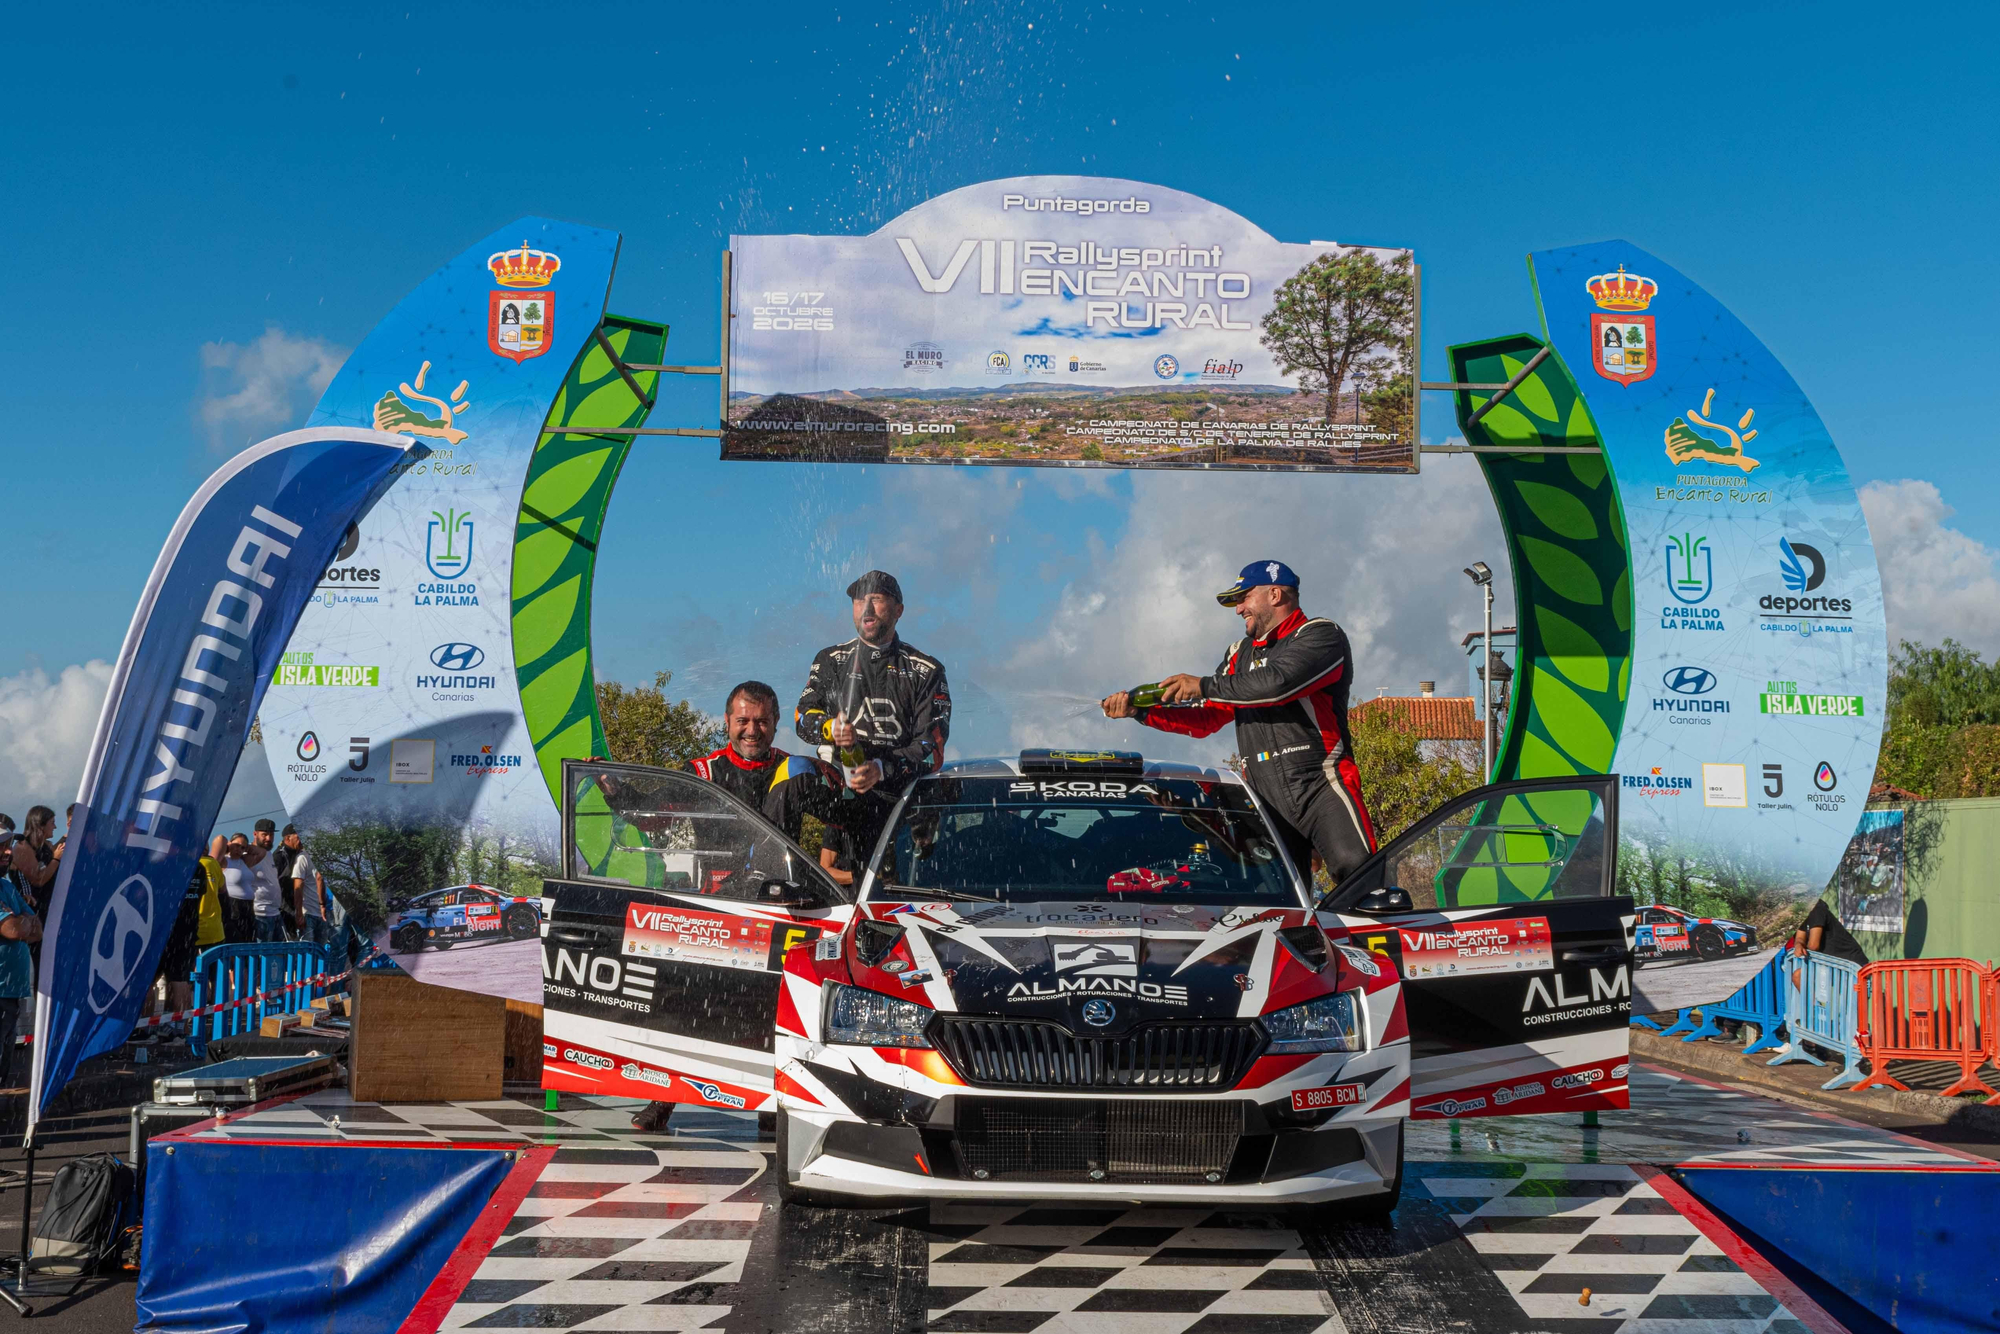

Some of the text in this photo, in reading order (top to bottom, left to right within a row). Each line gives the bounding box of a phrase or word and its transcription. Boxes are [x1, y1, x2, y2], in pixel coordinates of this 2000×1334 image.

[1003, 194, 1150, 215] Puntagorda
[1024, 240, 1222, 270] Rallysprint
[896, 238, 1015, 294] VII
[1020, 269, 1250, 299] ENCANTO
[763, 291, 825, 306] 16/17
[753, 306, 834, 316] OCTUBRE
[1087, 301, 1251, 330] RURAL
[753, 317, 834, 331] 2026
[905, 350, 943, 360] EL MURO
[992, 356, 1005, 367] FCA
[737, 420, 956, 435] www.elmuroracing.com
[1089, 419, 1377, 432] CAMPEONATO DE CANARIAS DE RALLYSPRINT
[1066, 427, 1155, 436] CAMPEONATO
[1179, 429, 1203, 438] S/C
[1227, 430, 1290, 438] TENERIFE
[1293, 431, 1311, 439] DE
[1314, 432, 1400, 441] RALLYSPRINT
[1104, 436, 1193, 445] CAMPEONATO
[1195, 437, 1214, 445] DE
[1217, 438, 1235, 446] LA
[1307, 440, 1362, 448] RALLIES
[433, 461, 478, 476] Rural
[1676, 474, 1748, 487] PUNTAGORDA
[1655, 486, 1773, 504] Encanto Rural
[418, 583, 476, 594] CABILDO
[414, 595, 479, 607] LA PALMA
[1759, 594, 1852, 614] deportes
[1662, 606, 1720, 619] CABILDO
[1661, 618, 1725, 631] LA PALMA
[1760, 623, 1853, 634] CABILDO LA PALMA
[282, 652, 314, 664] AUTOS
[126, 504, 303, 855] HYUNDAI
[280, 665, 372, 686] ISLA VERDE
[416, 675, 496, 689] HYUNDAI
[1766, 681, 1797, 694] AUTOS
[432, 692, 475, 702] Canarias
[1652, 698, 1730, 713] HYUNDAI
[1766, 694, 1858, 716] ISLA VERDE
[1669, 715, 1712, 726] Canarias
[1281, 744, 1311, 755] Afonso
[287, 762, 327, 773] RÓTULOS
[466, 765, 510, 778] Express
[294, 773, 318, 782] NOLO
[1042, 791, 1127, 799] CANARIAS
[1639, 785, 1681, 799] Express
[1807, 791, 1846, 803] RÓTULOS
[1815, 803, 1838, 812] NOLO
[453, 916, 478, 926] FLAT
[467, 919, 501, 932] RIGHT
[631, 909, 724, 931] VII Rallysprint
[1024, 912, 1159, 926] trocadero
[659, 922, 731, 939] ENCANTO
[678, 934, 730, 950] RURAL
[1402, 927, 1499, 951] VII Rallysprint
[1436, 935, 1509, 950] ENCANTO
[1641, 936, 1666, 947] FLAT
[1367, 936, 1389, 957] 5
[1457, 946, 1510, 958] RURAL
[1656, 940, 1689, 952] RIGHT
[1007, 977, 1188, 1001] ALMANOE
[1522, 964, 1631, 1013] ALM
[582, 991, 651, 1013] TRANSPORTES
[1007, 990, 1188, 1006] CONSTRUCCIONES ROTURACIONES TRANSPORTES
[1523, 1004, 1612, 1026] CONSTRUCCIONES
[643, 1068, 668, 1079] KIOSCO
[639, 1074, 671, 1087] ARIDANE
[1513, 1087, 1545, 1100] ARIDANE
[1515, 1082, 1541, 1093] KIOSCO
[1295, 1087, 1356, 1107] S 8805 BCM
